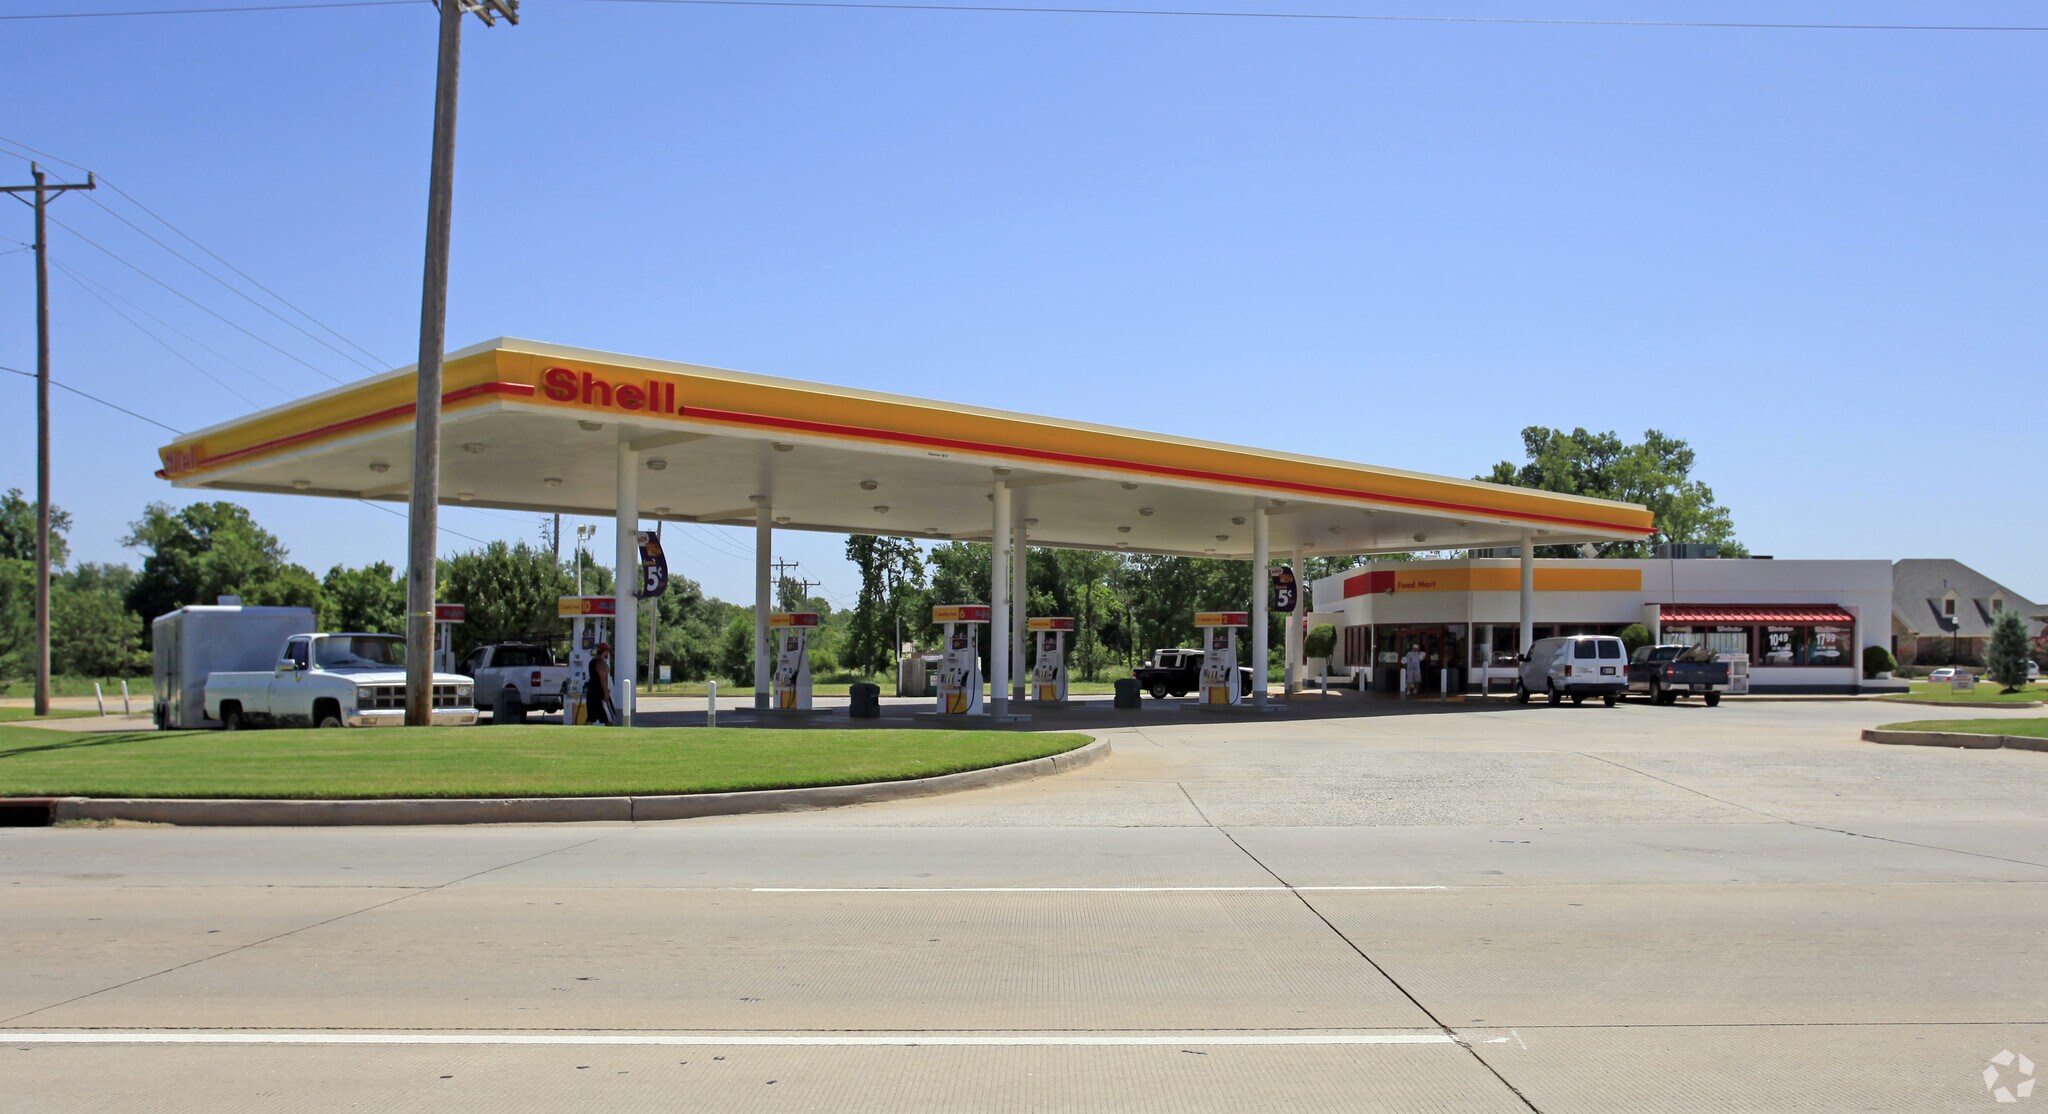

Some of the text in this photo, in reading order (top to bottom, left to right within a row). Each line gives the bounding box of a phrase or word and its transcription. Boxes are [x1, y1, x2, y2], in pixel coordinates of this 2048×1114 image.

[544, 367, 675, 414] Shell
[164, 446, 197, 474] Shell
[1397, 580, 1415, 589] Food
[582, 600, 590, 612] 10
